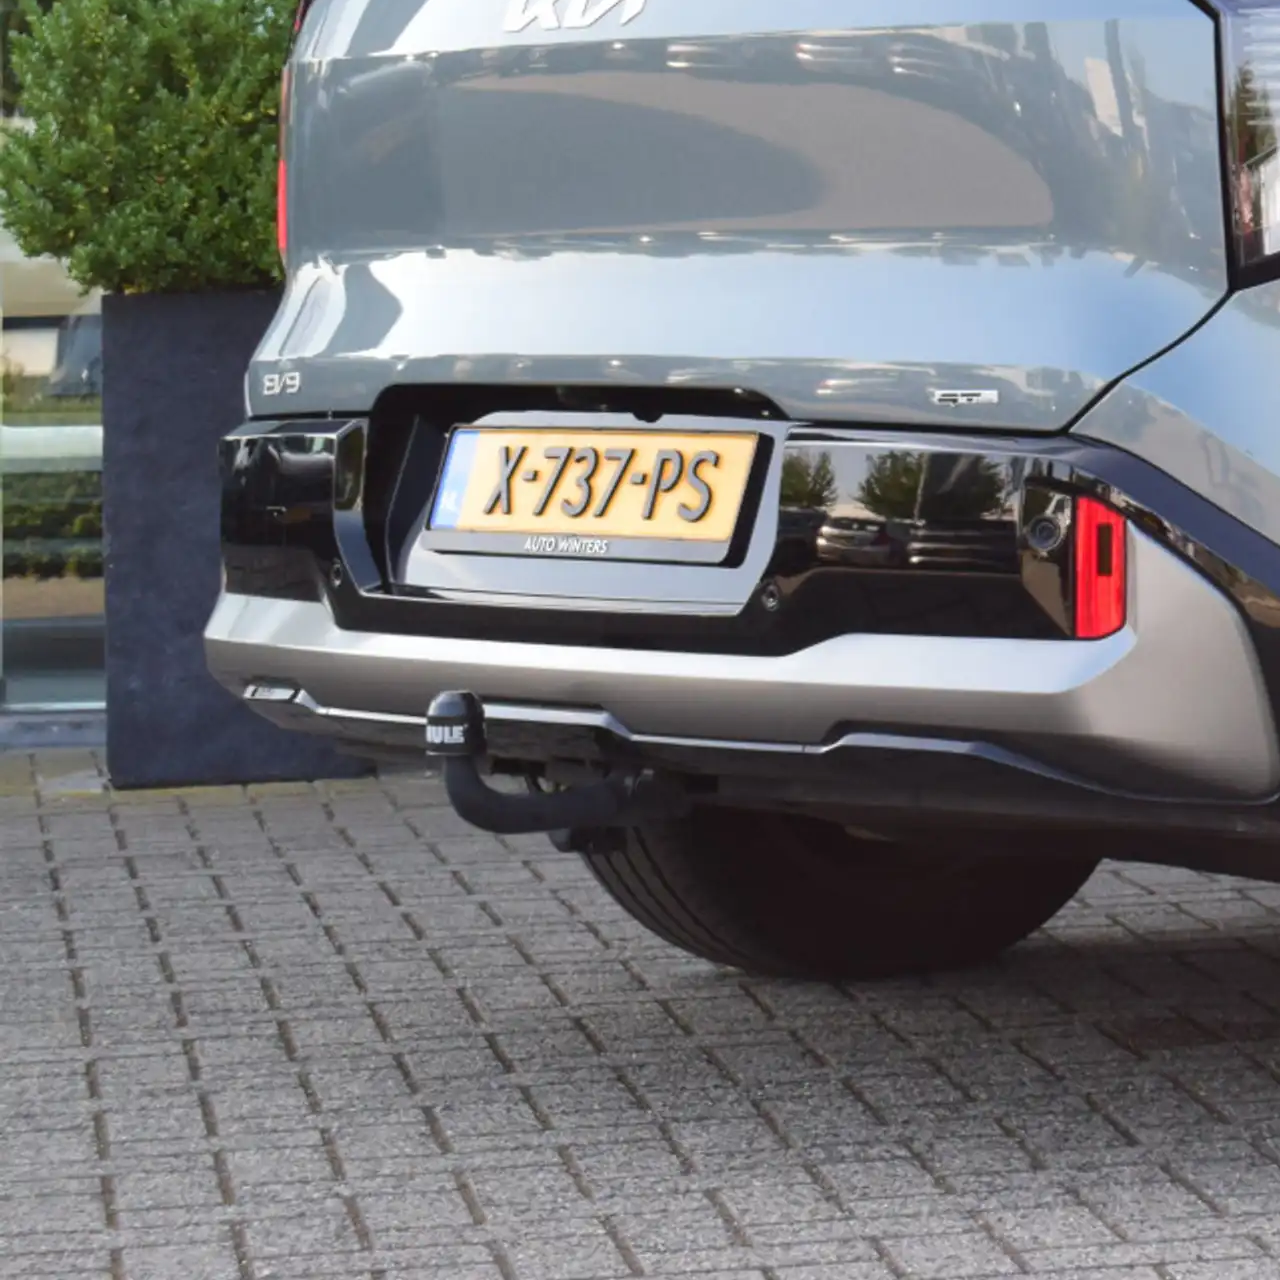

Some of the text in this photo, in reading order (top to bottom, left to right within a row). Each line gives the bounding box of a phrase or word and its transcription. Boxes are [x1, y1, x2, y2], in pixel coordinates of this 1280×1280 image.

[483, 445, 720, 523] X-737-PS
[523, 535, 609, 554] AUTO WINTERS
